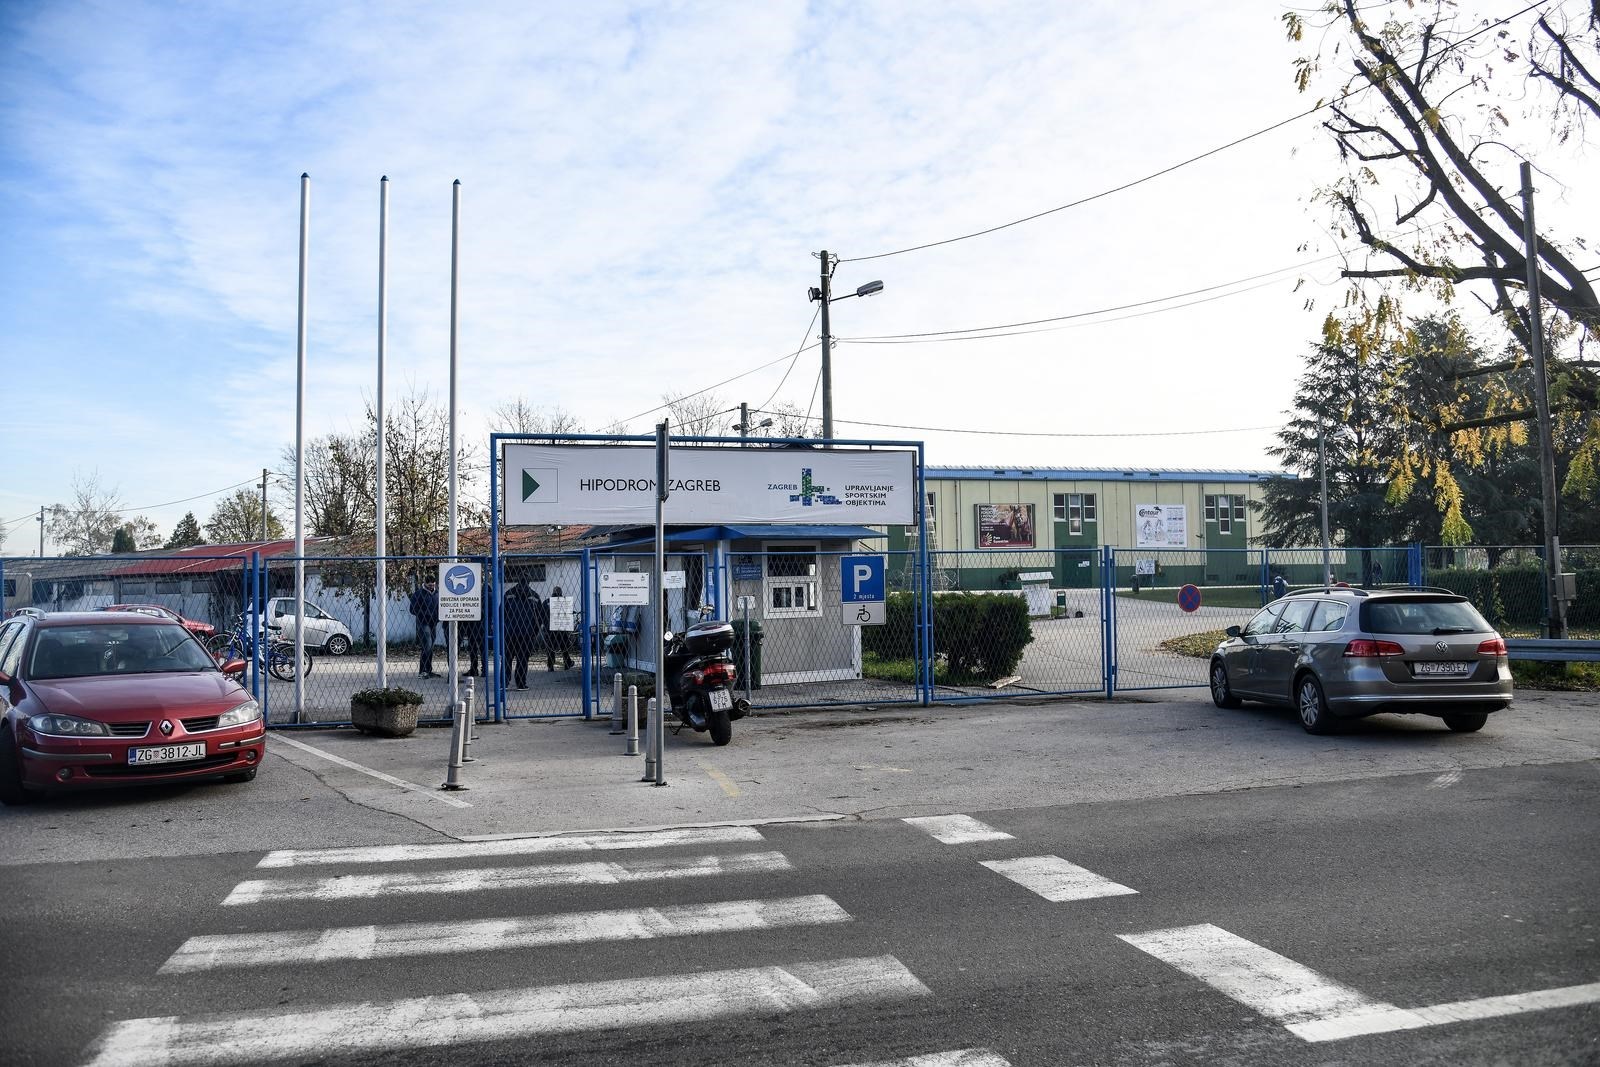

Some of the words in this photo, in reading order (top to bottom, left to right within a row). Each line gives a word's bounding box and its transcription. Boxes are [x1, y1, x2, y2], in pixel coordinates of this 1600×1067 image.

[668, 479, 721, 492] ZAGREB
[853, 564, 872, 593] P
[137, 749, 152, 761] ZG
